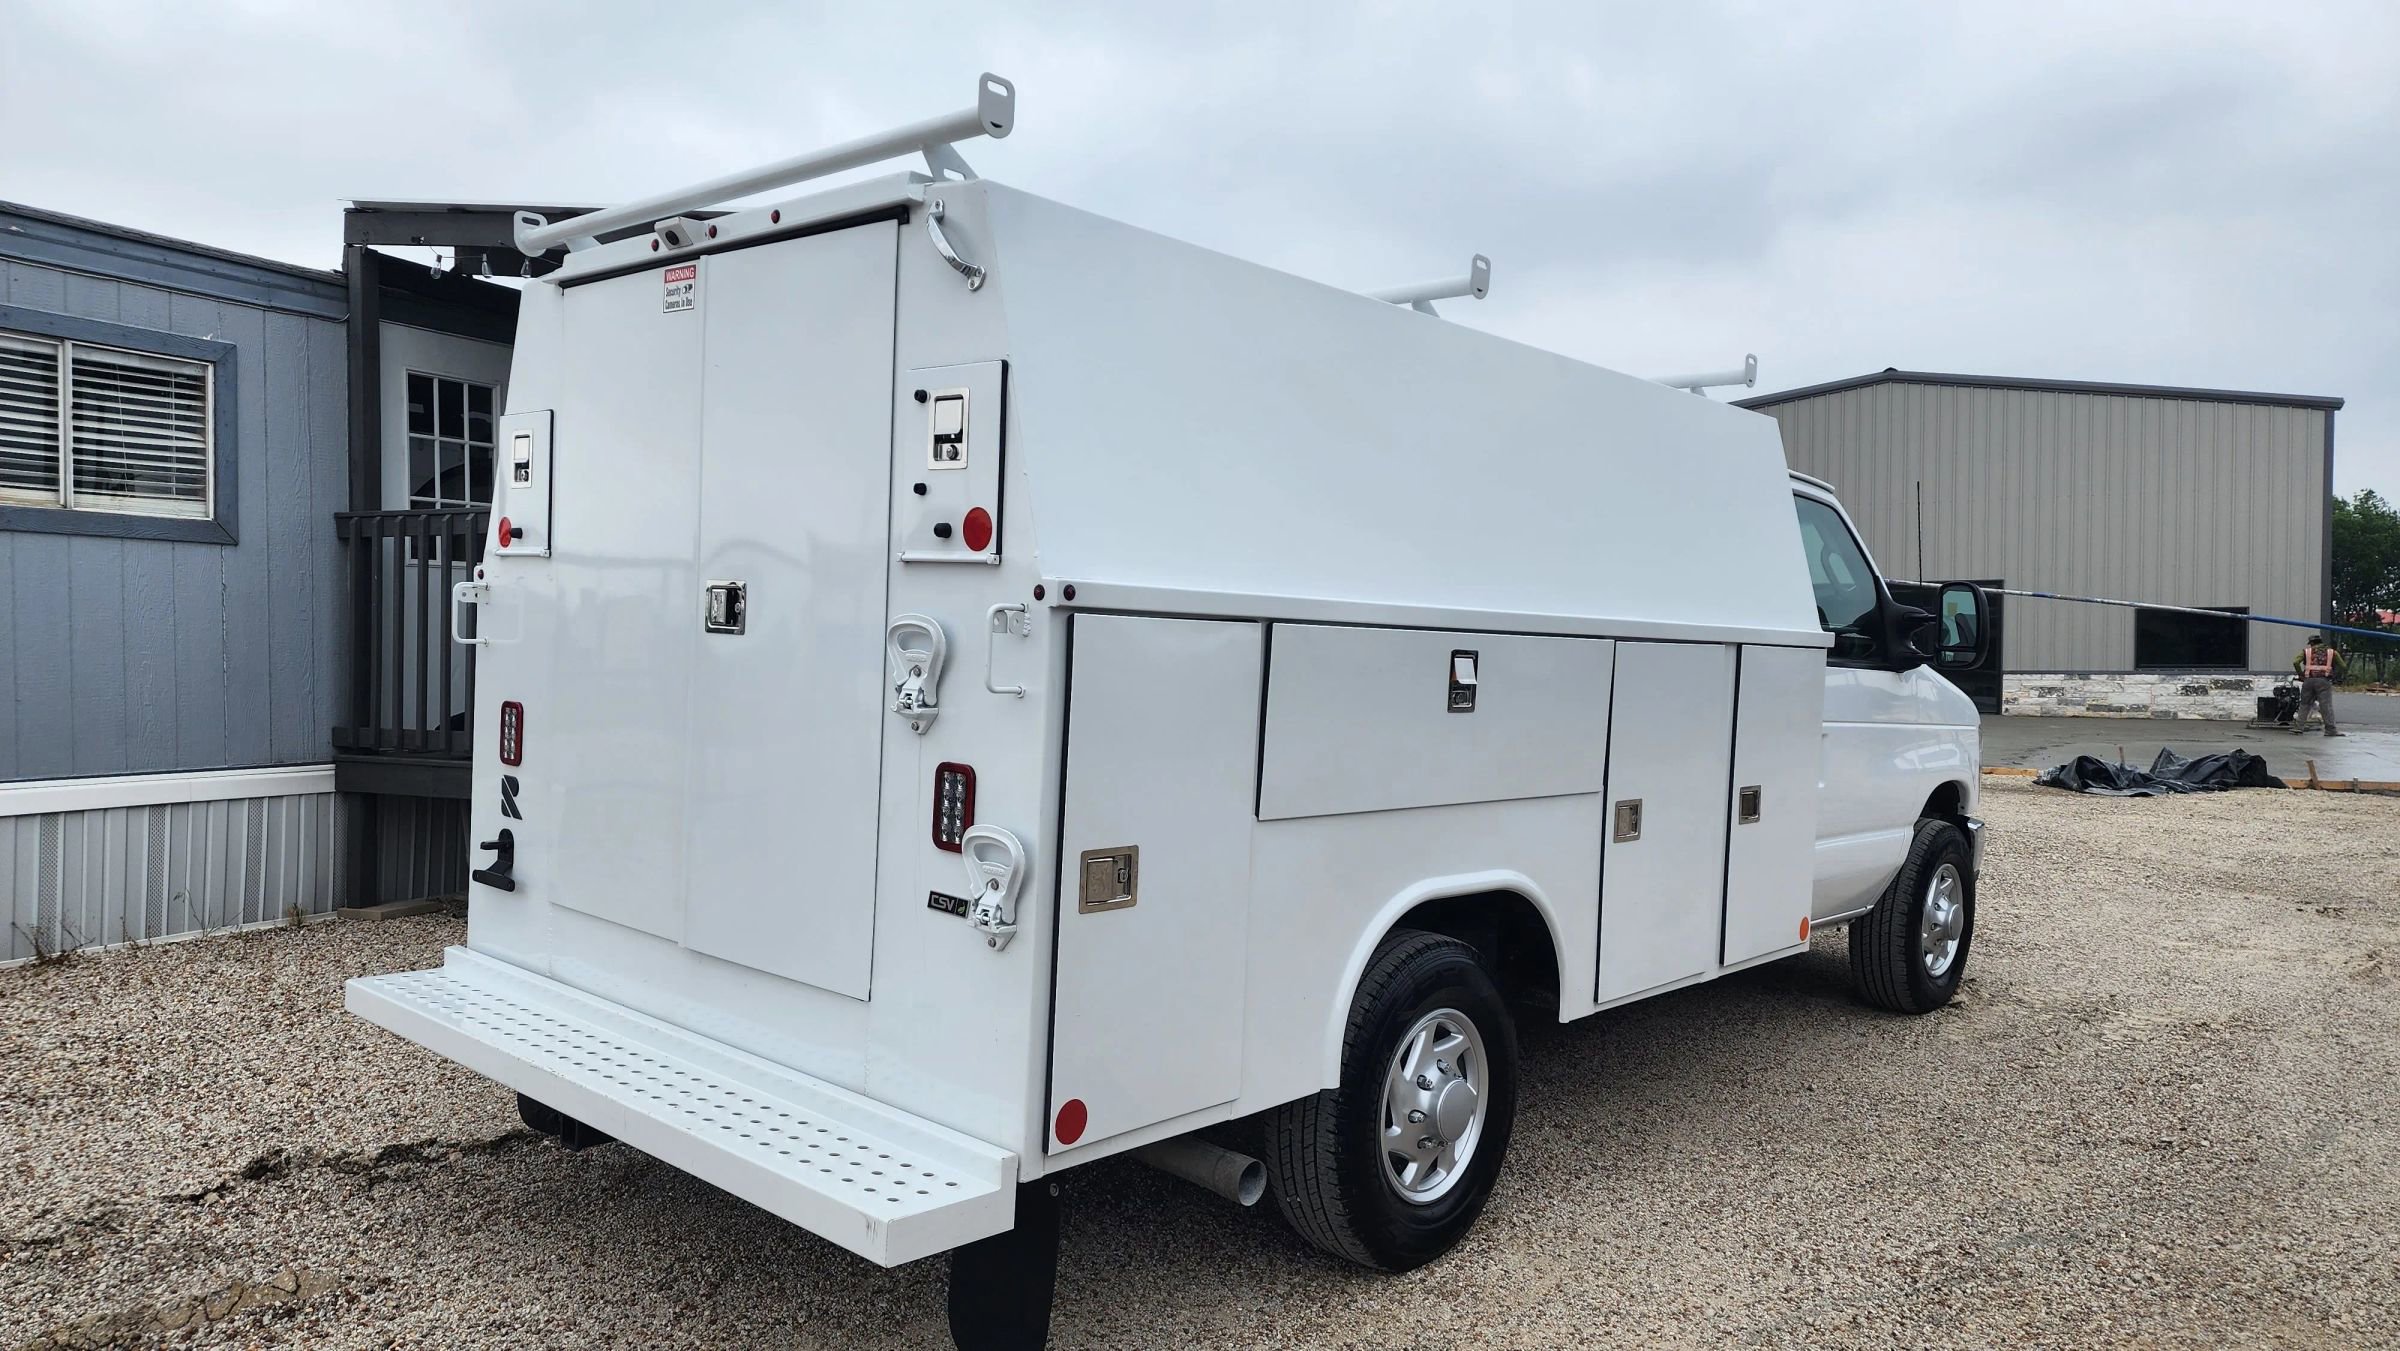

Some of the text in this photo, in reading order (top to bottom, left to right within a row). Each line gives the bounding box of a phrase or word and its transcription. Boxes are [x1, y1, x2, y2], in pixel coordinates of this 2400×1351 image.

[666, 267, 694, 282] WARNING
[666, 285, 681, 297] Security
[665, 299, 680, 310] Cameras
[931, 894, 955, 911] CSV
